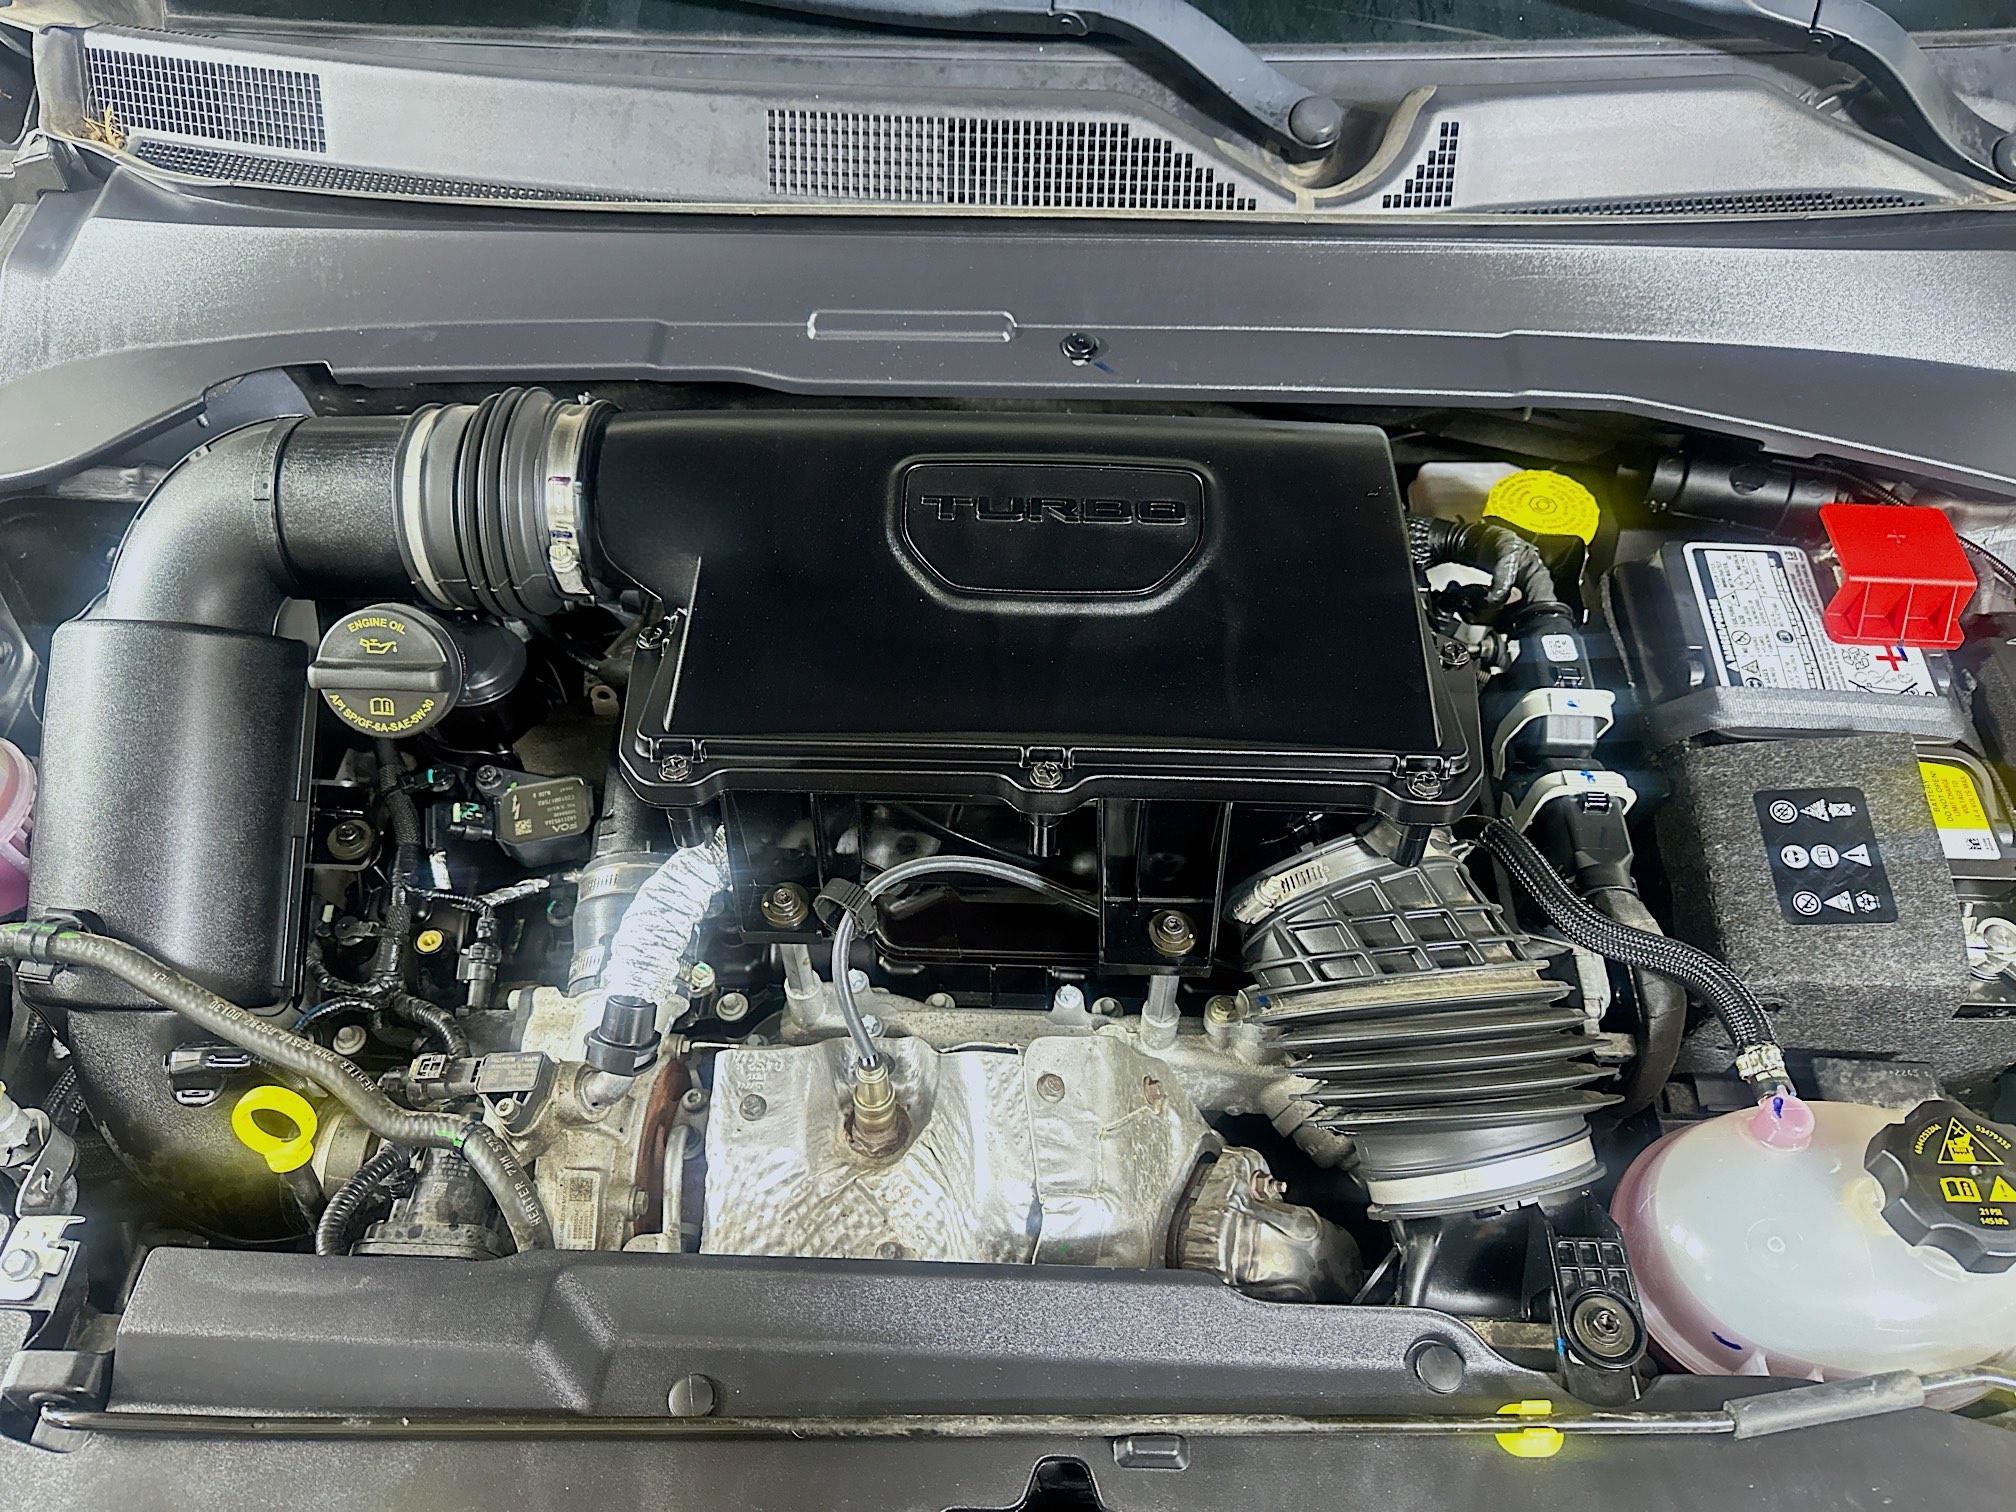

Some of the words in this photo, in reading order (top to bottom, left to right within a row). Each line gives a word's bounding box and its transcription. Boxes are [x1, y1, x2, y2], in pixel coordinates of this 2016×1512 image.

[920, 496, 1188, 526] TURBO
[347, 617, 388, 633] ENGINE
[389, 621, 406, 635] OIL
[329, 693, 345, 711] API
[1939, 795, 1949, 810] NOT
[1945, 810, 1954, 822] DO
[340, 1060, 376, 1093] HEATER
[514, 1180, 542, 1227] HEATER
